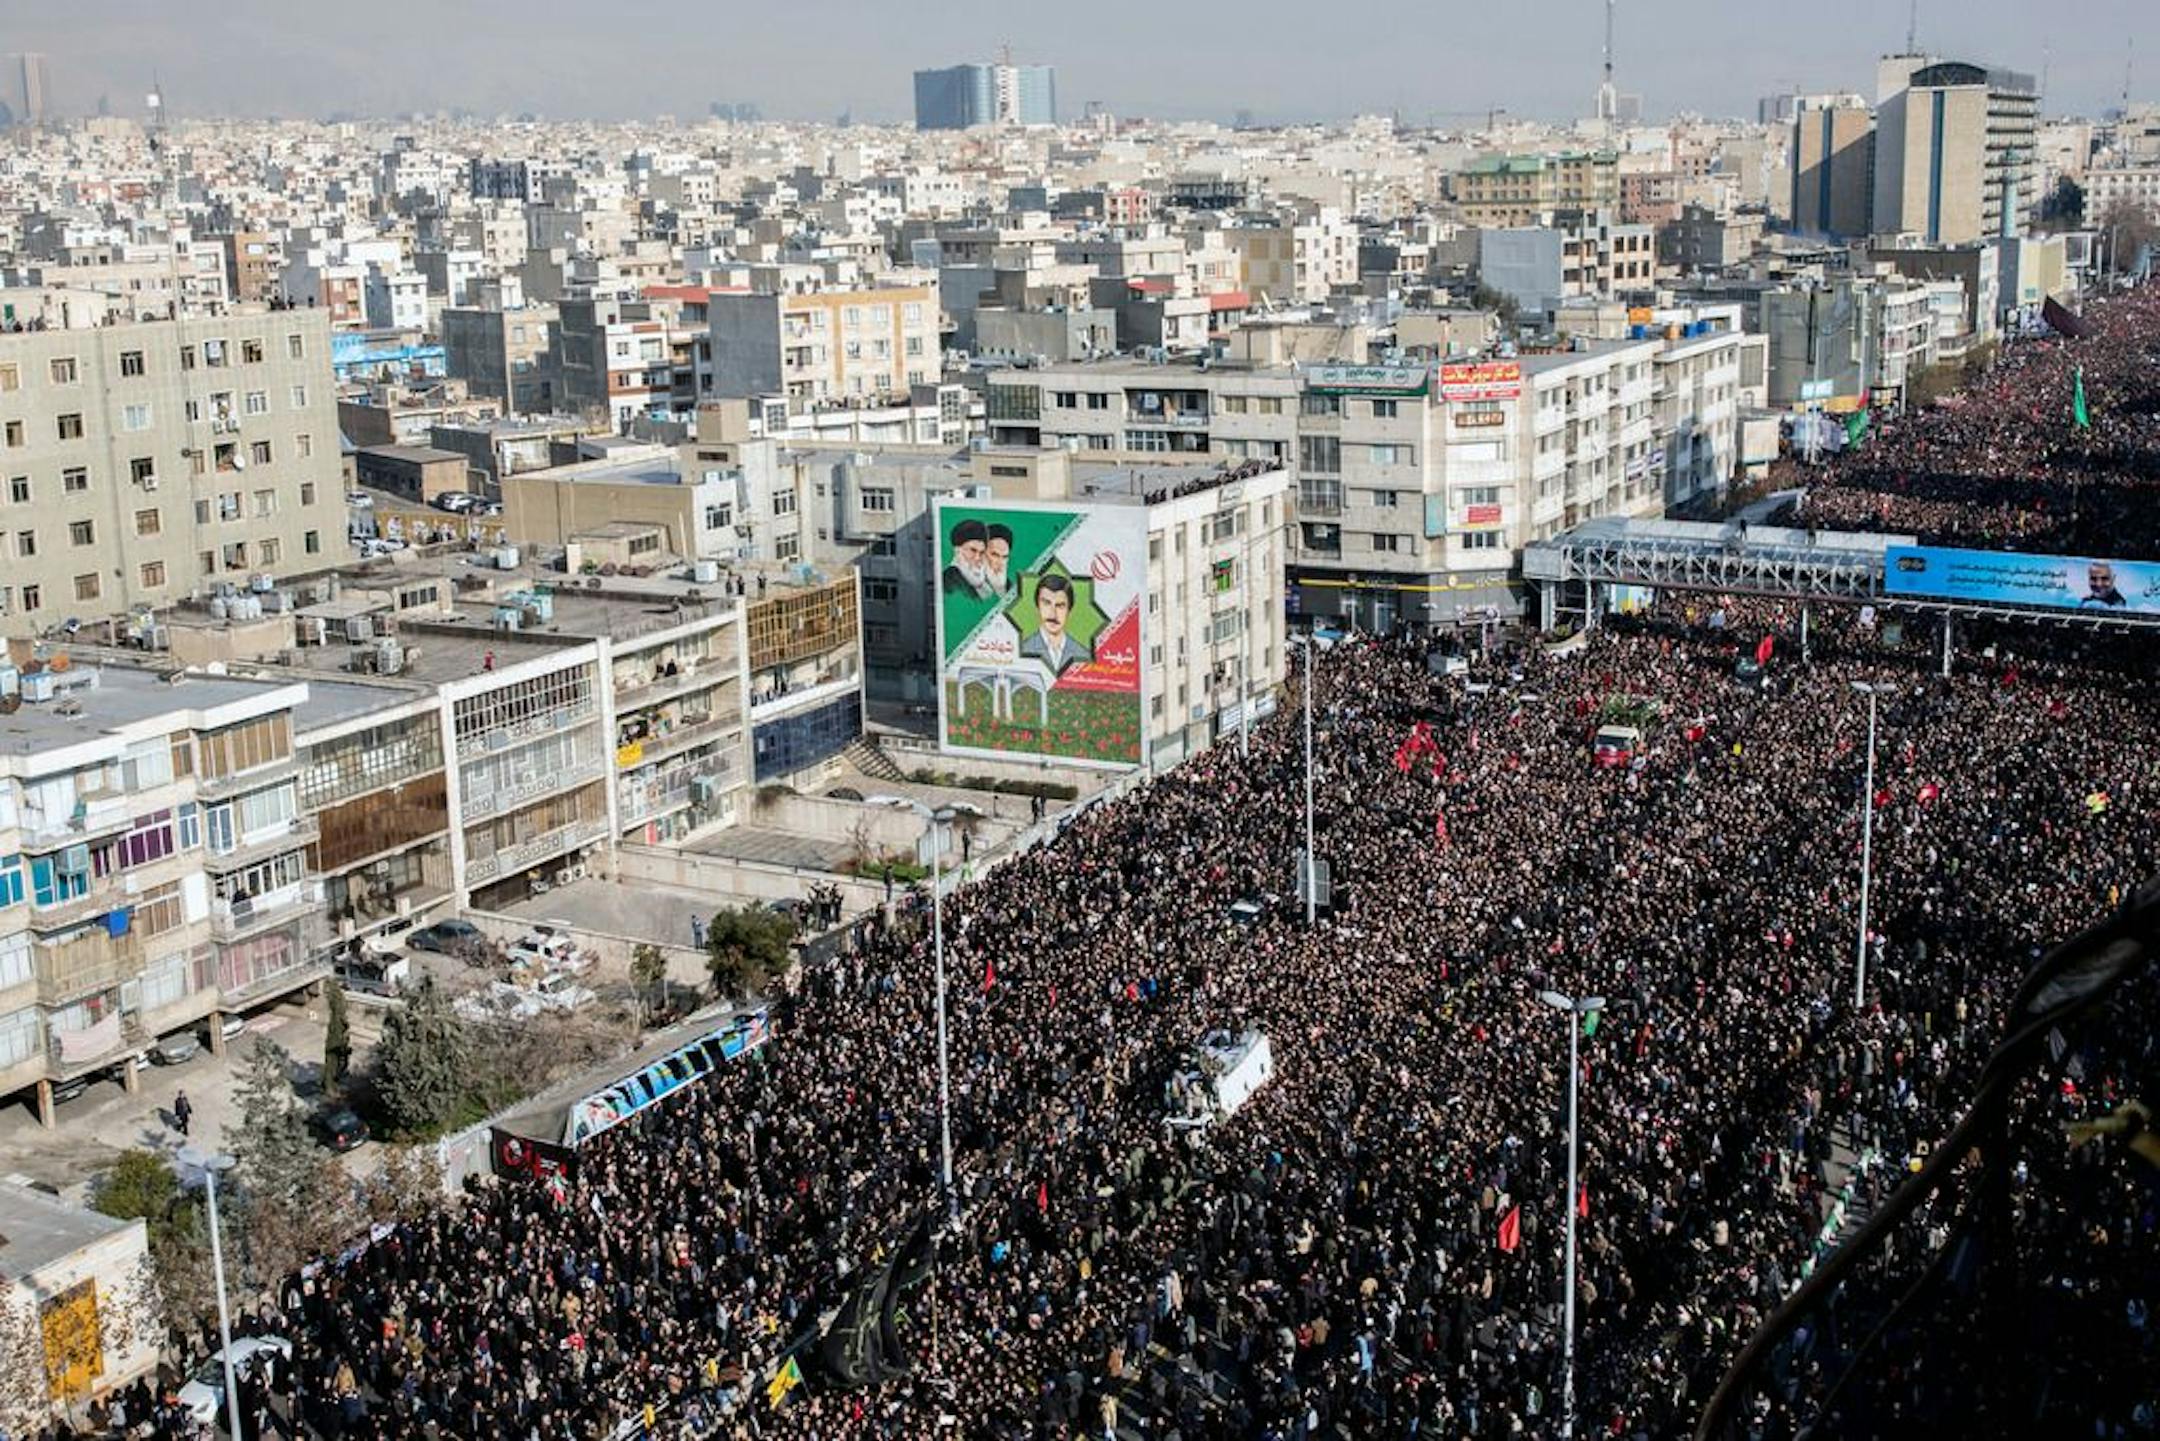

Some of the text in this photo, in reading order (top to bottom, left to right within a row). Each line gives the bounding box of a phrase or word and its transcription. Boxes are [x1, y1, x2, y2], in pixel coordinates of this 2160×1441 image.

[1997, 577, 2011, 588] حاج
[977, 639, 1014, 654] شهادت
[1102, 647, 1136, 665] شهید
